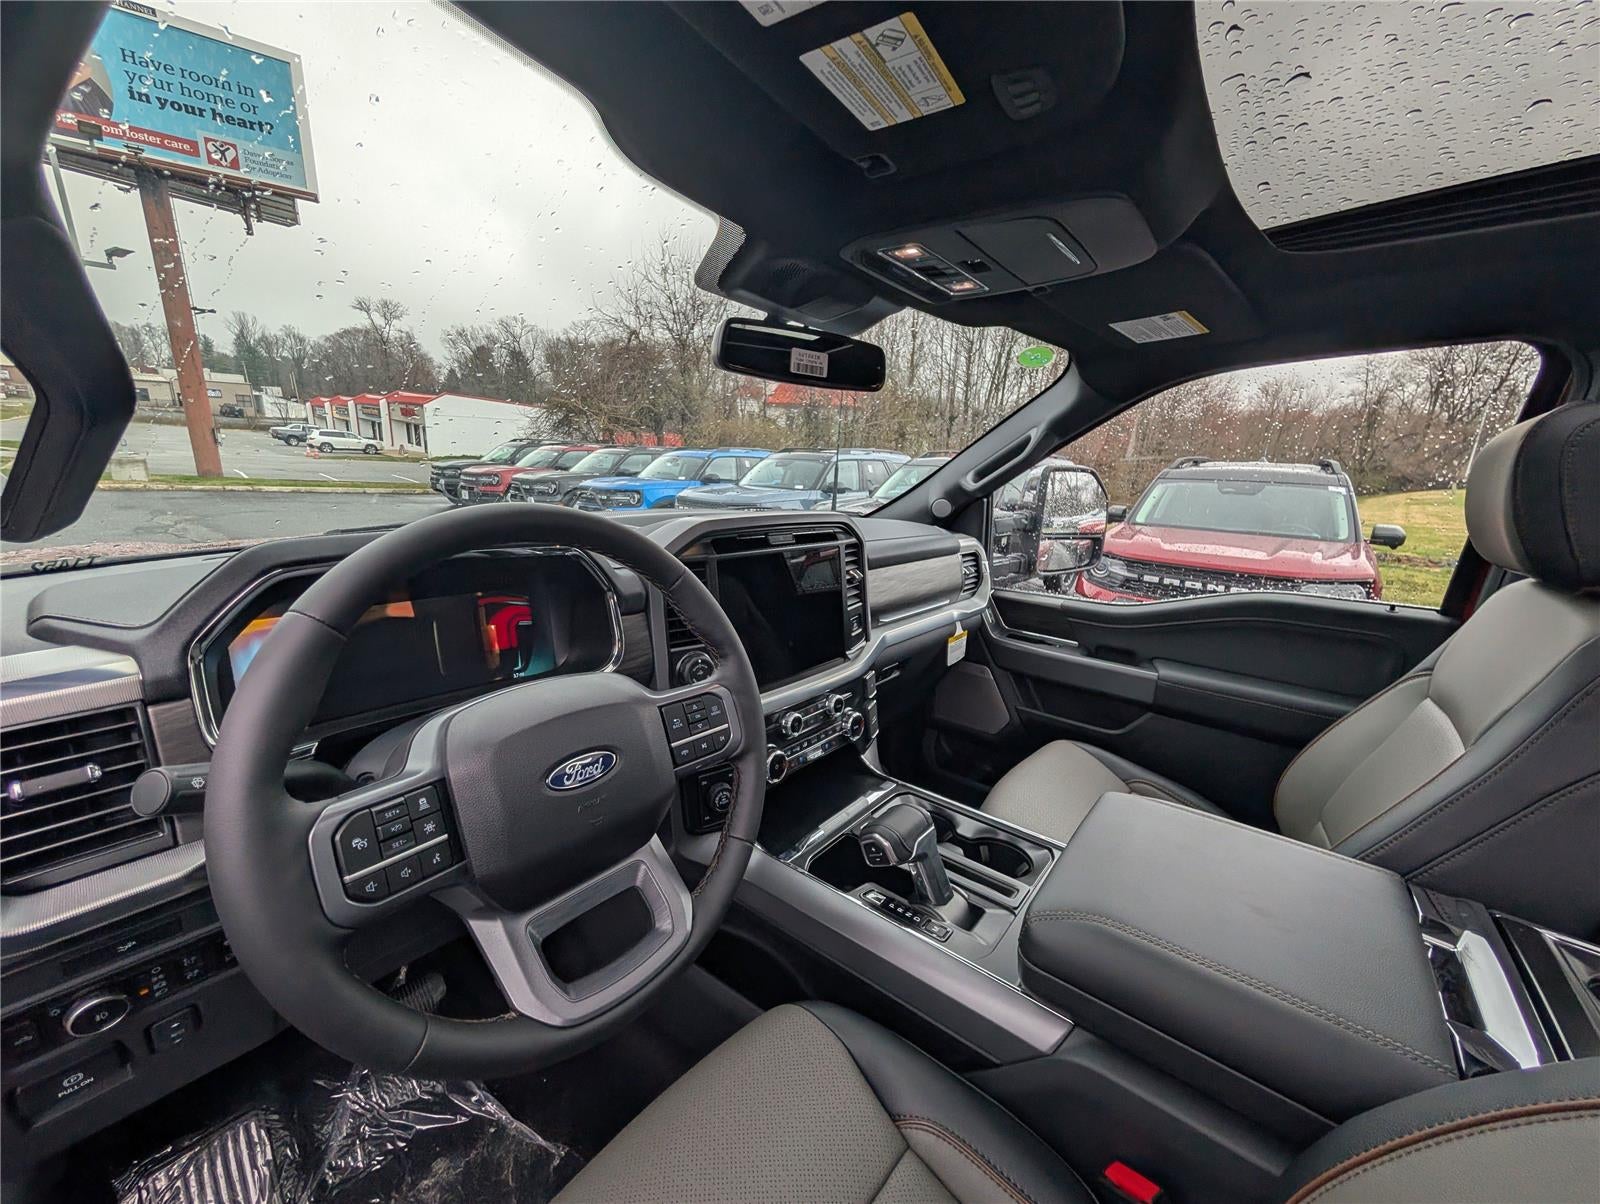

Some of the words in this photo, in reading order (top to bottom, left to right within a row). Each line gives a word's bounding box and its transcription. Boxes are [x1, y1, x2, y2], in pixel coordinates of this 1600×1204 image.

[119, 47, 175, 76] Have
[179, 67, 233, 92] room
[236, 81, 256, 98] in
[123, 70, 174, 93] your
[178, 81, 236, 110] home
[240, 102, 259, 115] or
[127, 86, 152, 105] in
[154, 96, 207, 119] your
[209, 107, 275, 136] heart?
[125, 127, 162, 144] foster
[164, 138, 194, 152] care.
[563, 757, 605, 785] Ford
[58, 1085, 80, 1098] PULL
[80, 1076, 94, 1087] ON
